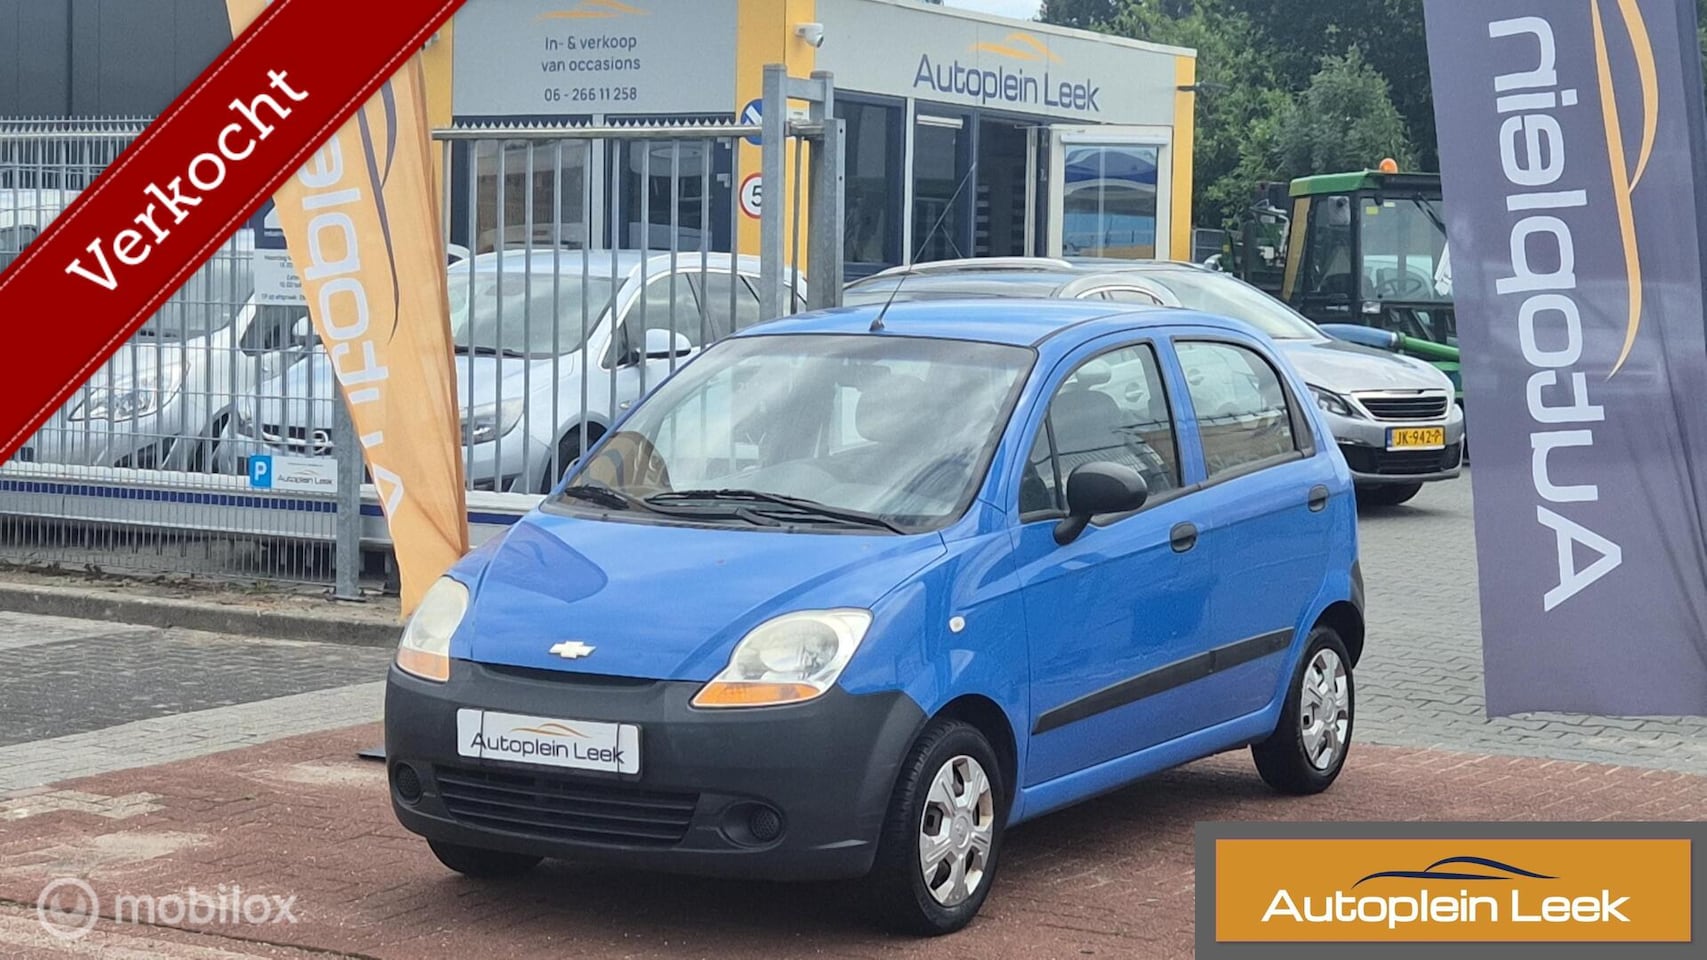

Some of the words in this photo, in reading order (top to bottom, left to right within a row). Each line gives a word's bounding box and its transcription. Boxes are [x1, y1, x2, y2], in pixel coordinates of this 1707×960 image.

[545, 36, 564, 50] In-
[567, 35, 576, 50] &
[579, 34, 637, 52] verkoop
[541, 60, 565, 72] van
[568, 55, 641, 71] occasions
[913, 53, 1038, 105] Autoplein
[1044, 72, 1100, 112] Leek
[544, 87, 561, 102] 06
[572, 87, 596, 101] 266
[599, 87, 610, 100] 11
[613, 86, 637, 100] 258
[254, 461, 268, 481] P
[470, 732, 569, 758] Autoplein
[573, 742, 625, 765] Leek
